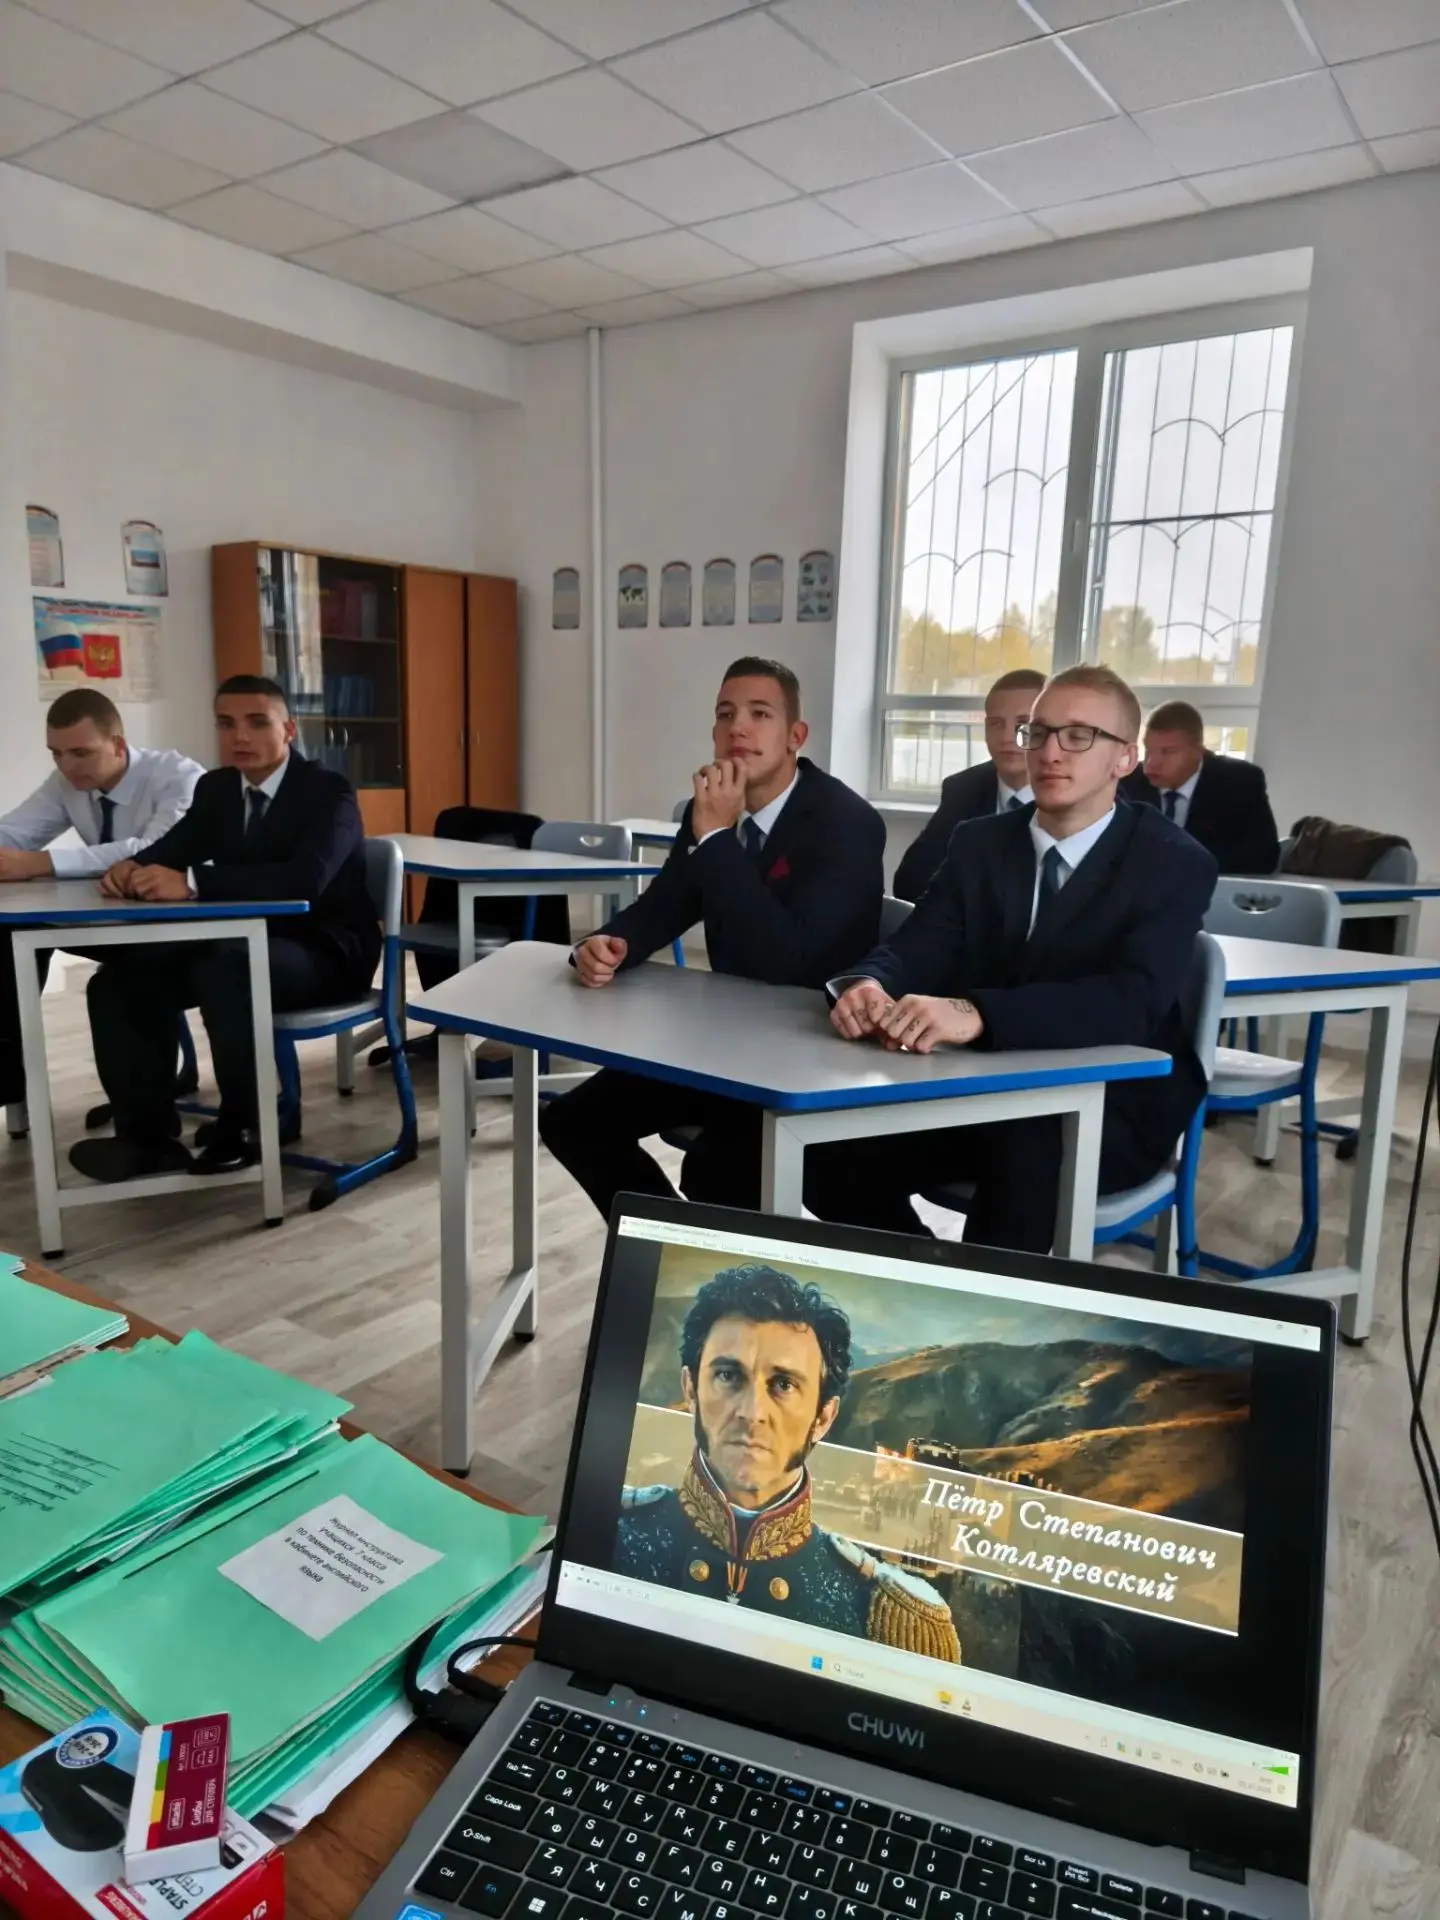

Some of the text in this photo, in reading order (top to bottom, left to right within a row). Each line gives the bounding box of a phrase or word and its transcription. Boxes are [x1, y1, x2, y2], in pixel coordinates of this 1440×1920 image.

[921, 1478, 1217, 1570] Пётр Степанович
[329, 1517, 404, 1565] Журнал инструктажа
[296, 1527, 385, 1584] по технике безопасности
[361, 1554, 387, 1571] класса
[950, 1524, 1179, 1602] Котляревский
[290, 1540, 324, 1564] кабинете
[321, 1563, 369, 1592] английского
[299, 1565, 324, 1582] языка
[848, 1712, 925, 1749] CHUWI
[506, 1762, 519, 1771] Tab
[207, 1777, 218, 1809] СТЕПЛЕРА
[484, 1794, 522, 1811] Caps Lock
[191, 1800, 203, 1826] Скобы
[899, 1813, 912, 1822] F10
[472, 1832, 492, 1843] Shift
[980, 1838, 993, 1847] F12
[439, 1867, 456, 1878] Ctrl
[485, 1883, 497, 1894] Fn
[1109, 1880, 1134, 1893] Delete
